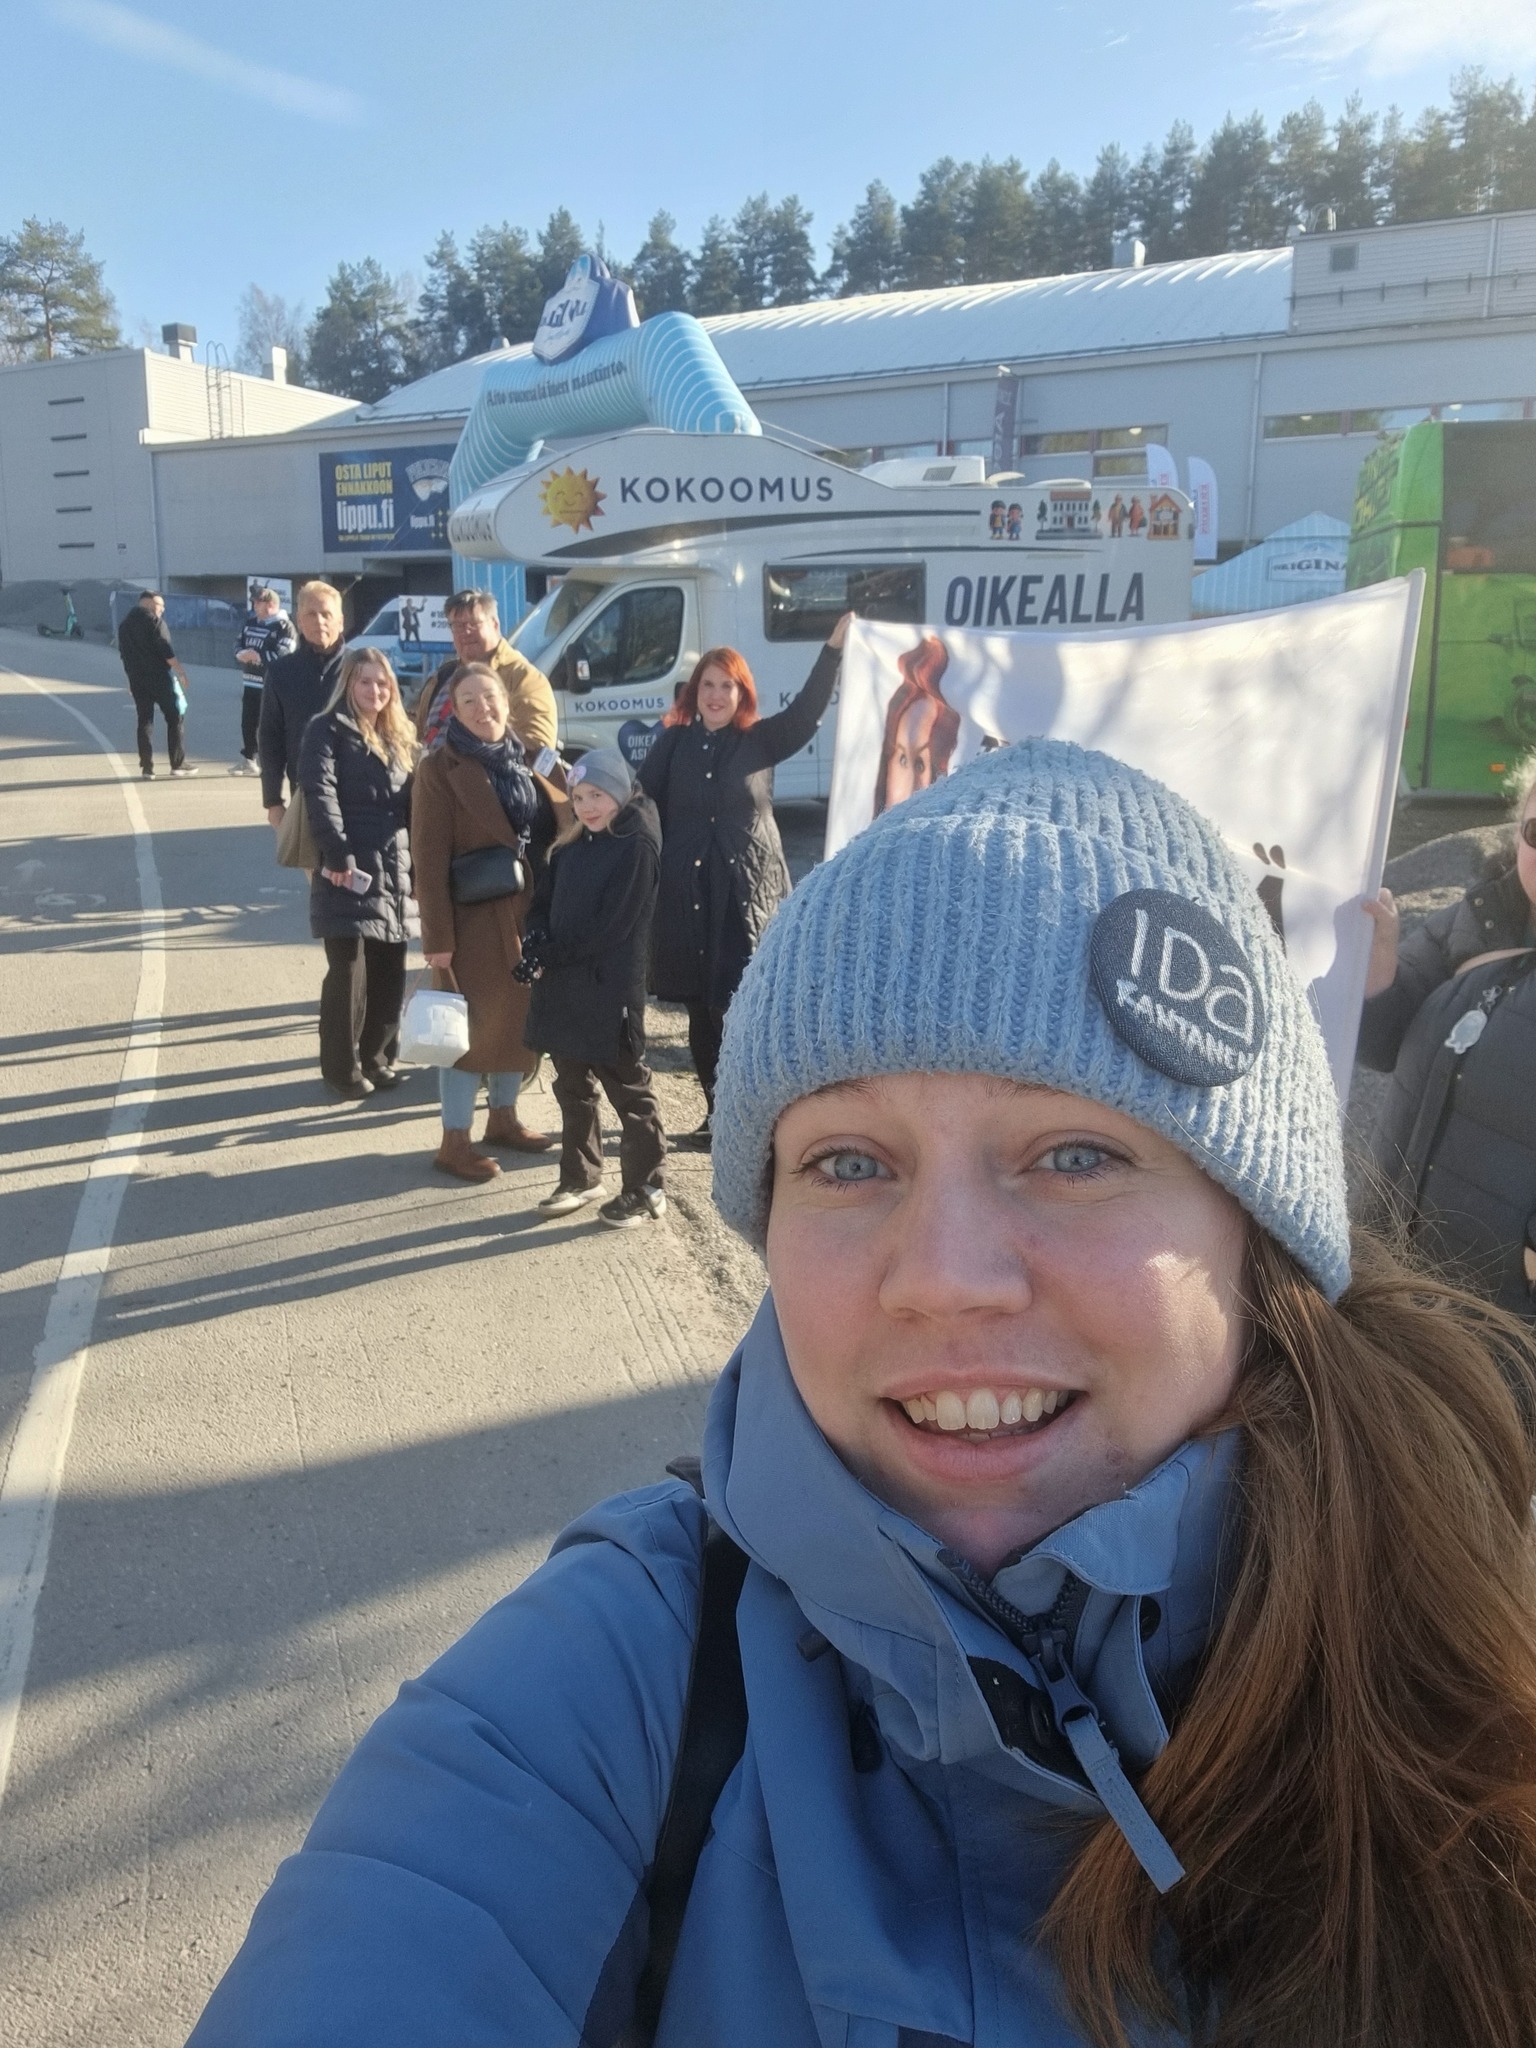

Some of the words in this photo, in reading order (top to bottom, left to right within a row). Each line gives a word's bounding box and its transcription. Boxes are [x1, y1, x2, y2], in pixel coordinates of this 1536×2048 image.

[335, 463, 362, 481] OSTA
[363, 461, 392, 480] LIPUT
[336, 479, 393, 497] ENNAKKOON
[620, 476, 834, 504] KOKOOMUS
[336, 498, 394, 533] lippu.fi
[944, 572, 1144, 627] OIKEALLA
[574, 697, 665, 713] KOKOOMUS
